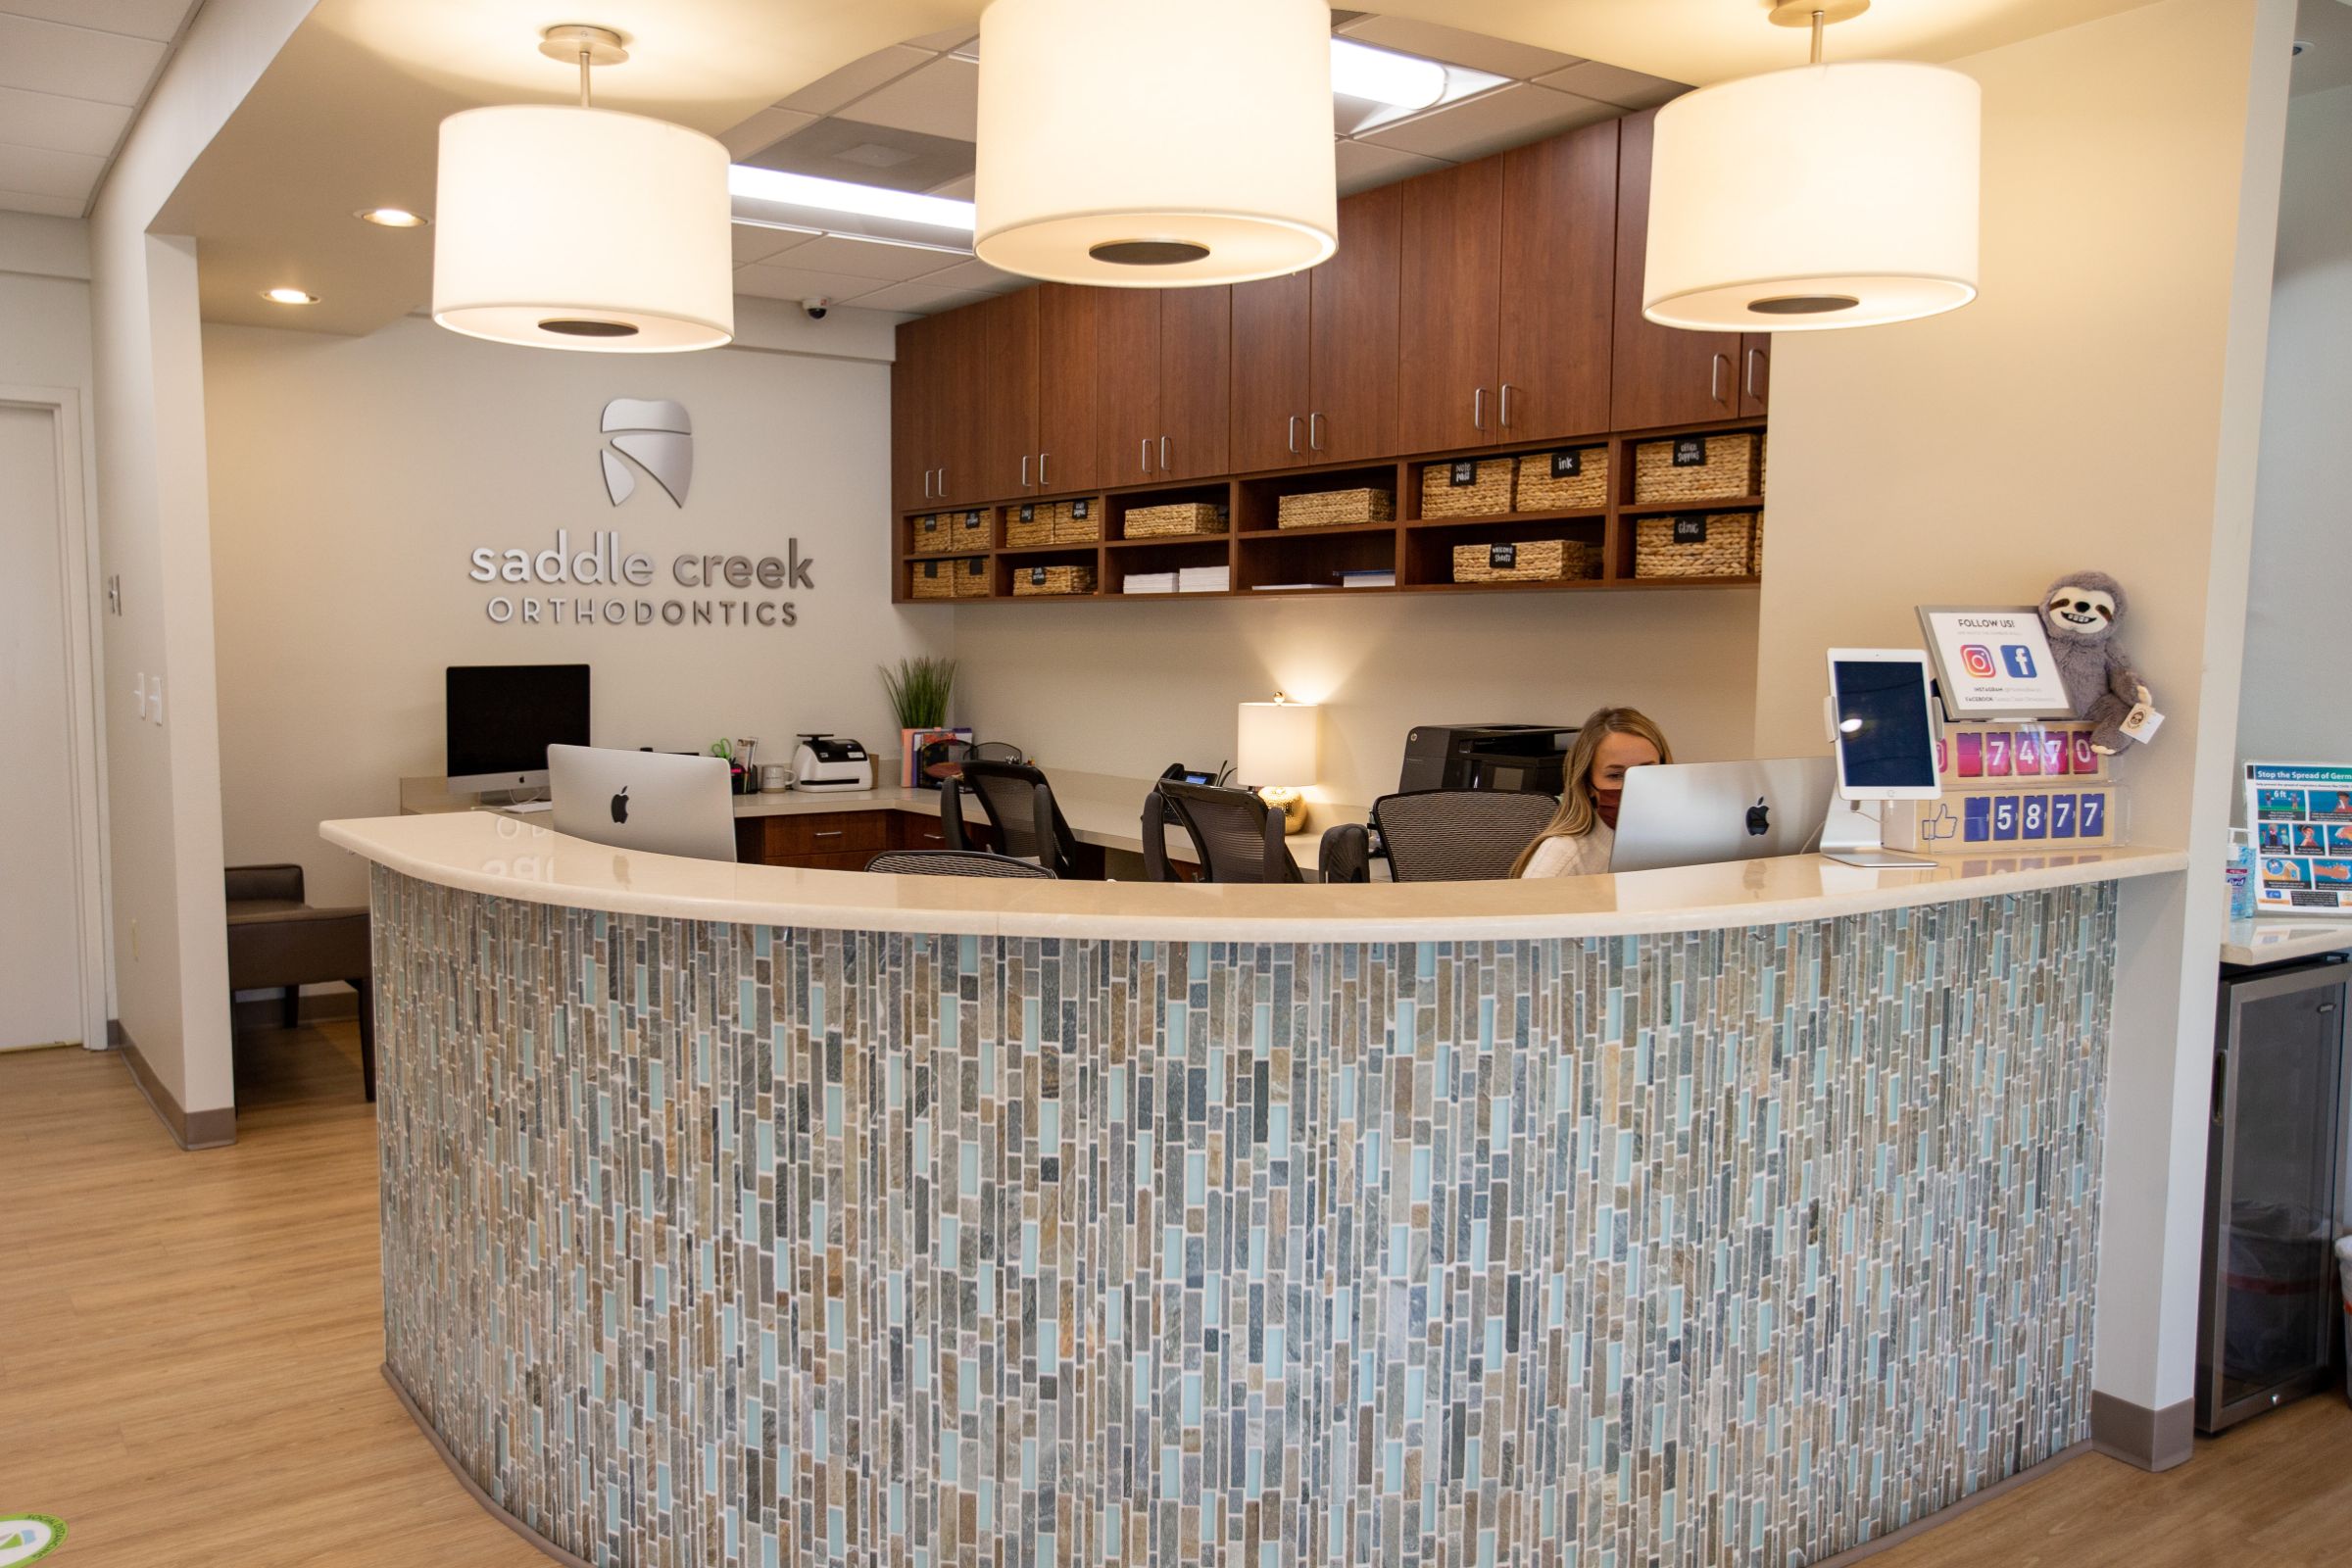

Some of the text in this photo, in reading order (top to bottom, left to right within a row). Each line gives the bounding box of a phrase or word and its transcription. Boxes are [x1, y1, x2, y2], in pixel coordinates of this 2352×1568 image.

[1558, 457, 1573, 470] ink
[469, 528, 815, 589] saddle creek
[487, 596, 799, 627] ORTHODONTICS
[1958, 618, 2015, 628] FOLLOW US!
[2257, 770, 2276, 779] Stop
[2291, 771, 2319, 780] Spread
